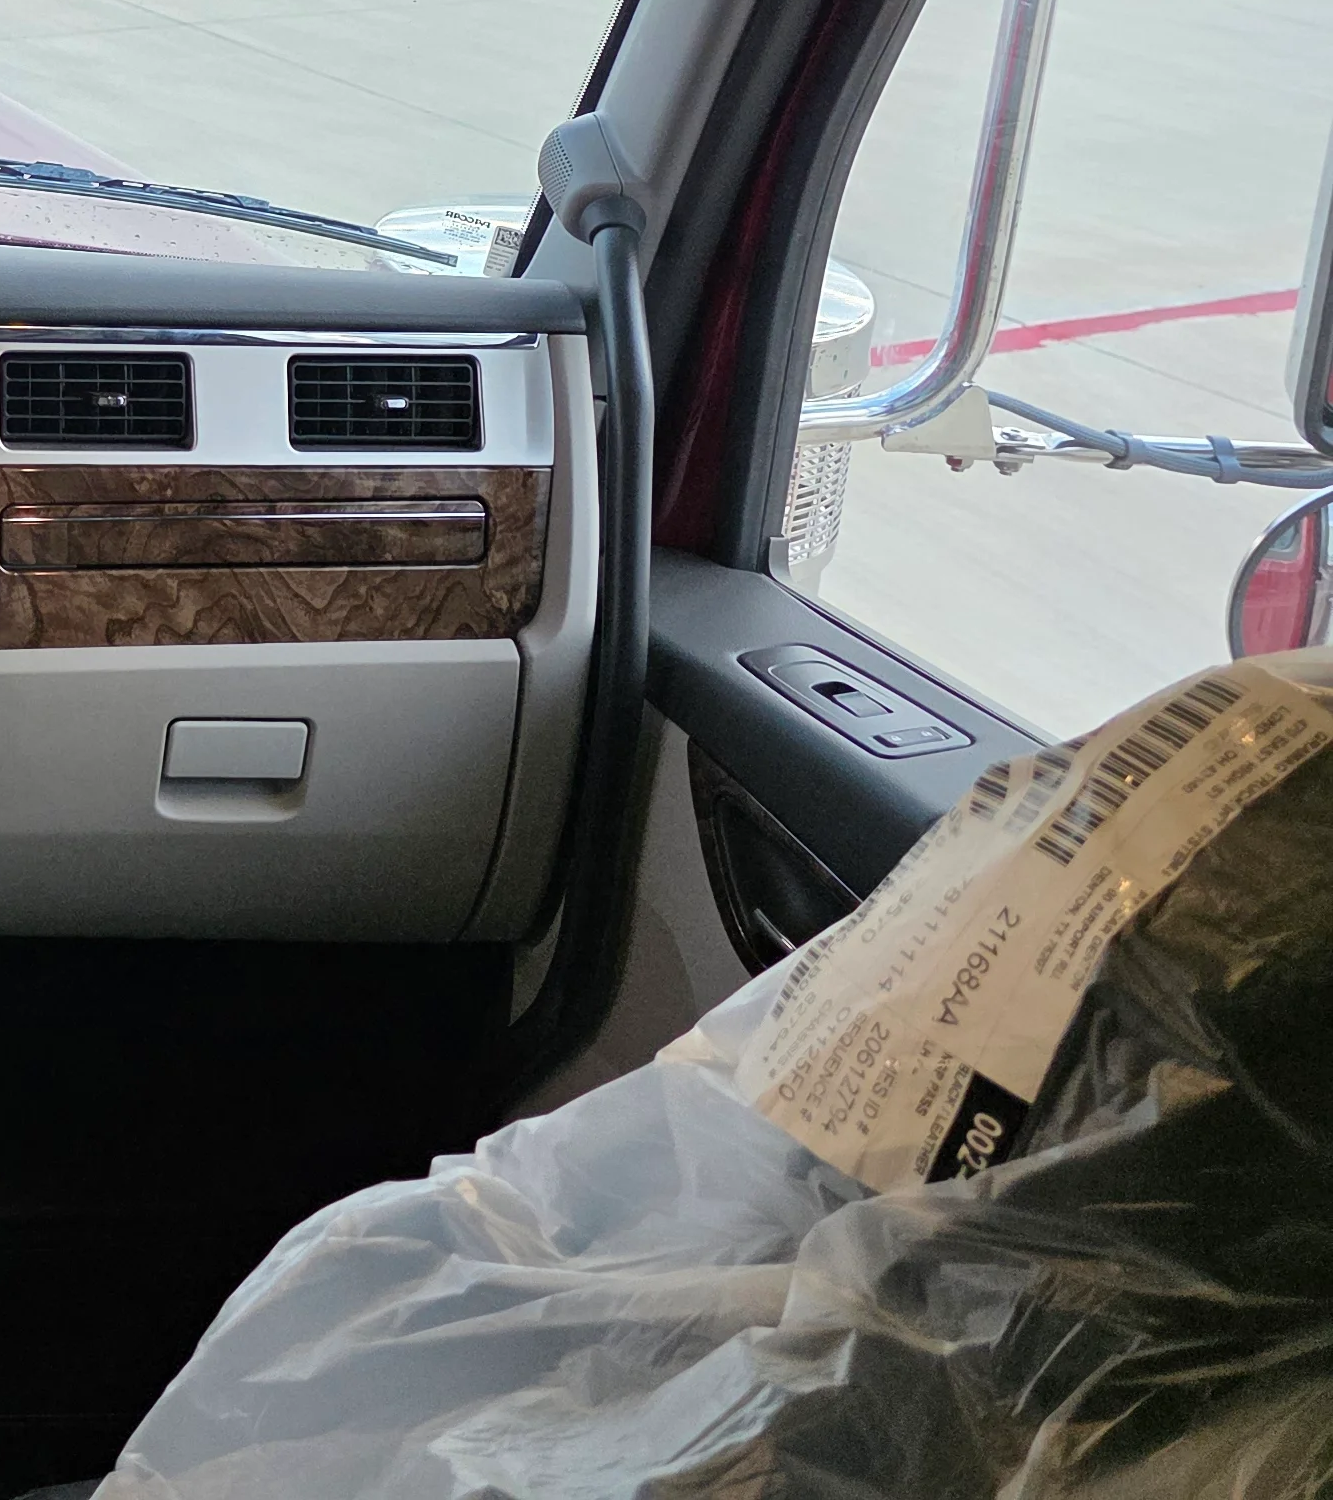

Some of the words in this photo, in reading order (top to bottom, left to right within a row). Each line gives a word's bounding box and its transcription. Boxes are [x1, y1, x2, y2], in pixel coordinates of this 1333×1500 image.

[1067, 900, 1105, 960] AIRPORT
[936, 904, 1021, 1028] 21168AA
[778, 998, 834, 1066] CHASSIS
[805, 1010, 868, 1105] SEQUENCE
[821, 1021, 890, 1136] 20612794
[915, 1076, 940, 1117] PASS
[948, 1063, 968, 1106] BLACK
[801, 1108, 813, 1124] #
[858, 1122, 871, 1136] #
[862, 1104, 879, 1121] ID
[915, 1112, 949, 1176] LEATHER
